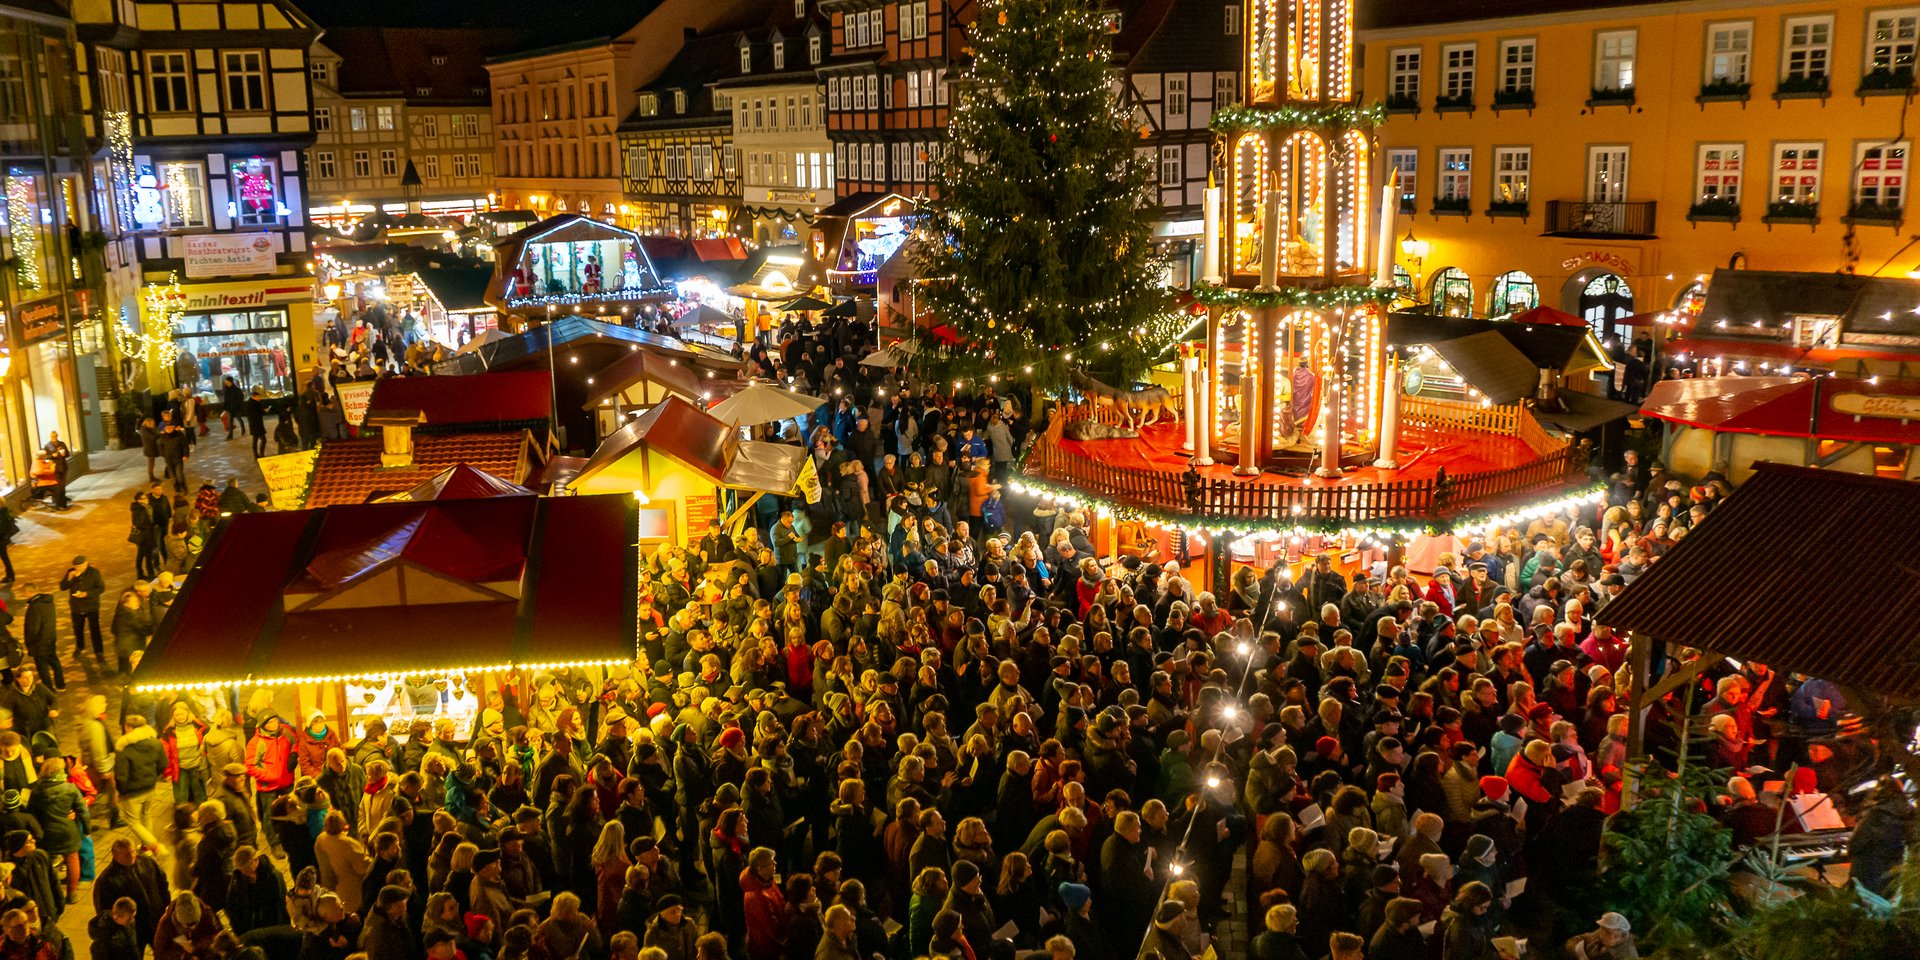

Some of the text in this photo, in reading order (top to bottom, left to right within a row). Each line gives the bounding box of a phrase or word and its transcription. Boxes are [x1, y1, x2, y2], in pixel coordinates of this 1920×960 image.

[187, 246, 251, 256] Rostbratwurst
[1562, 251, 1637, 277] SPARKASSE
[189, 291, 264, 308] minitextil
